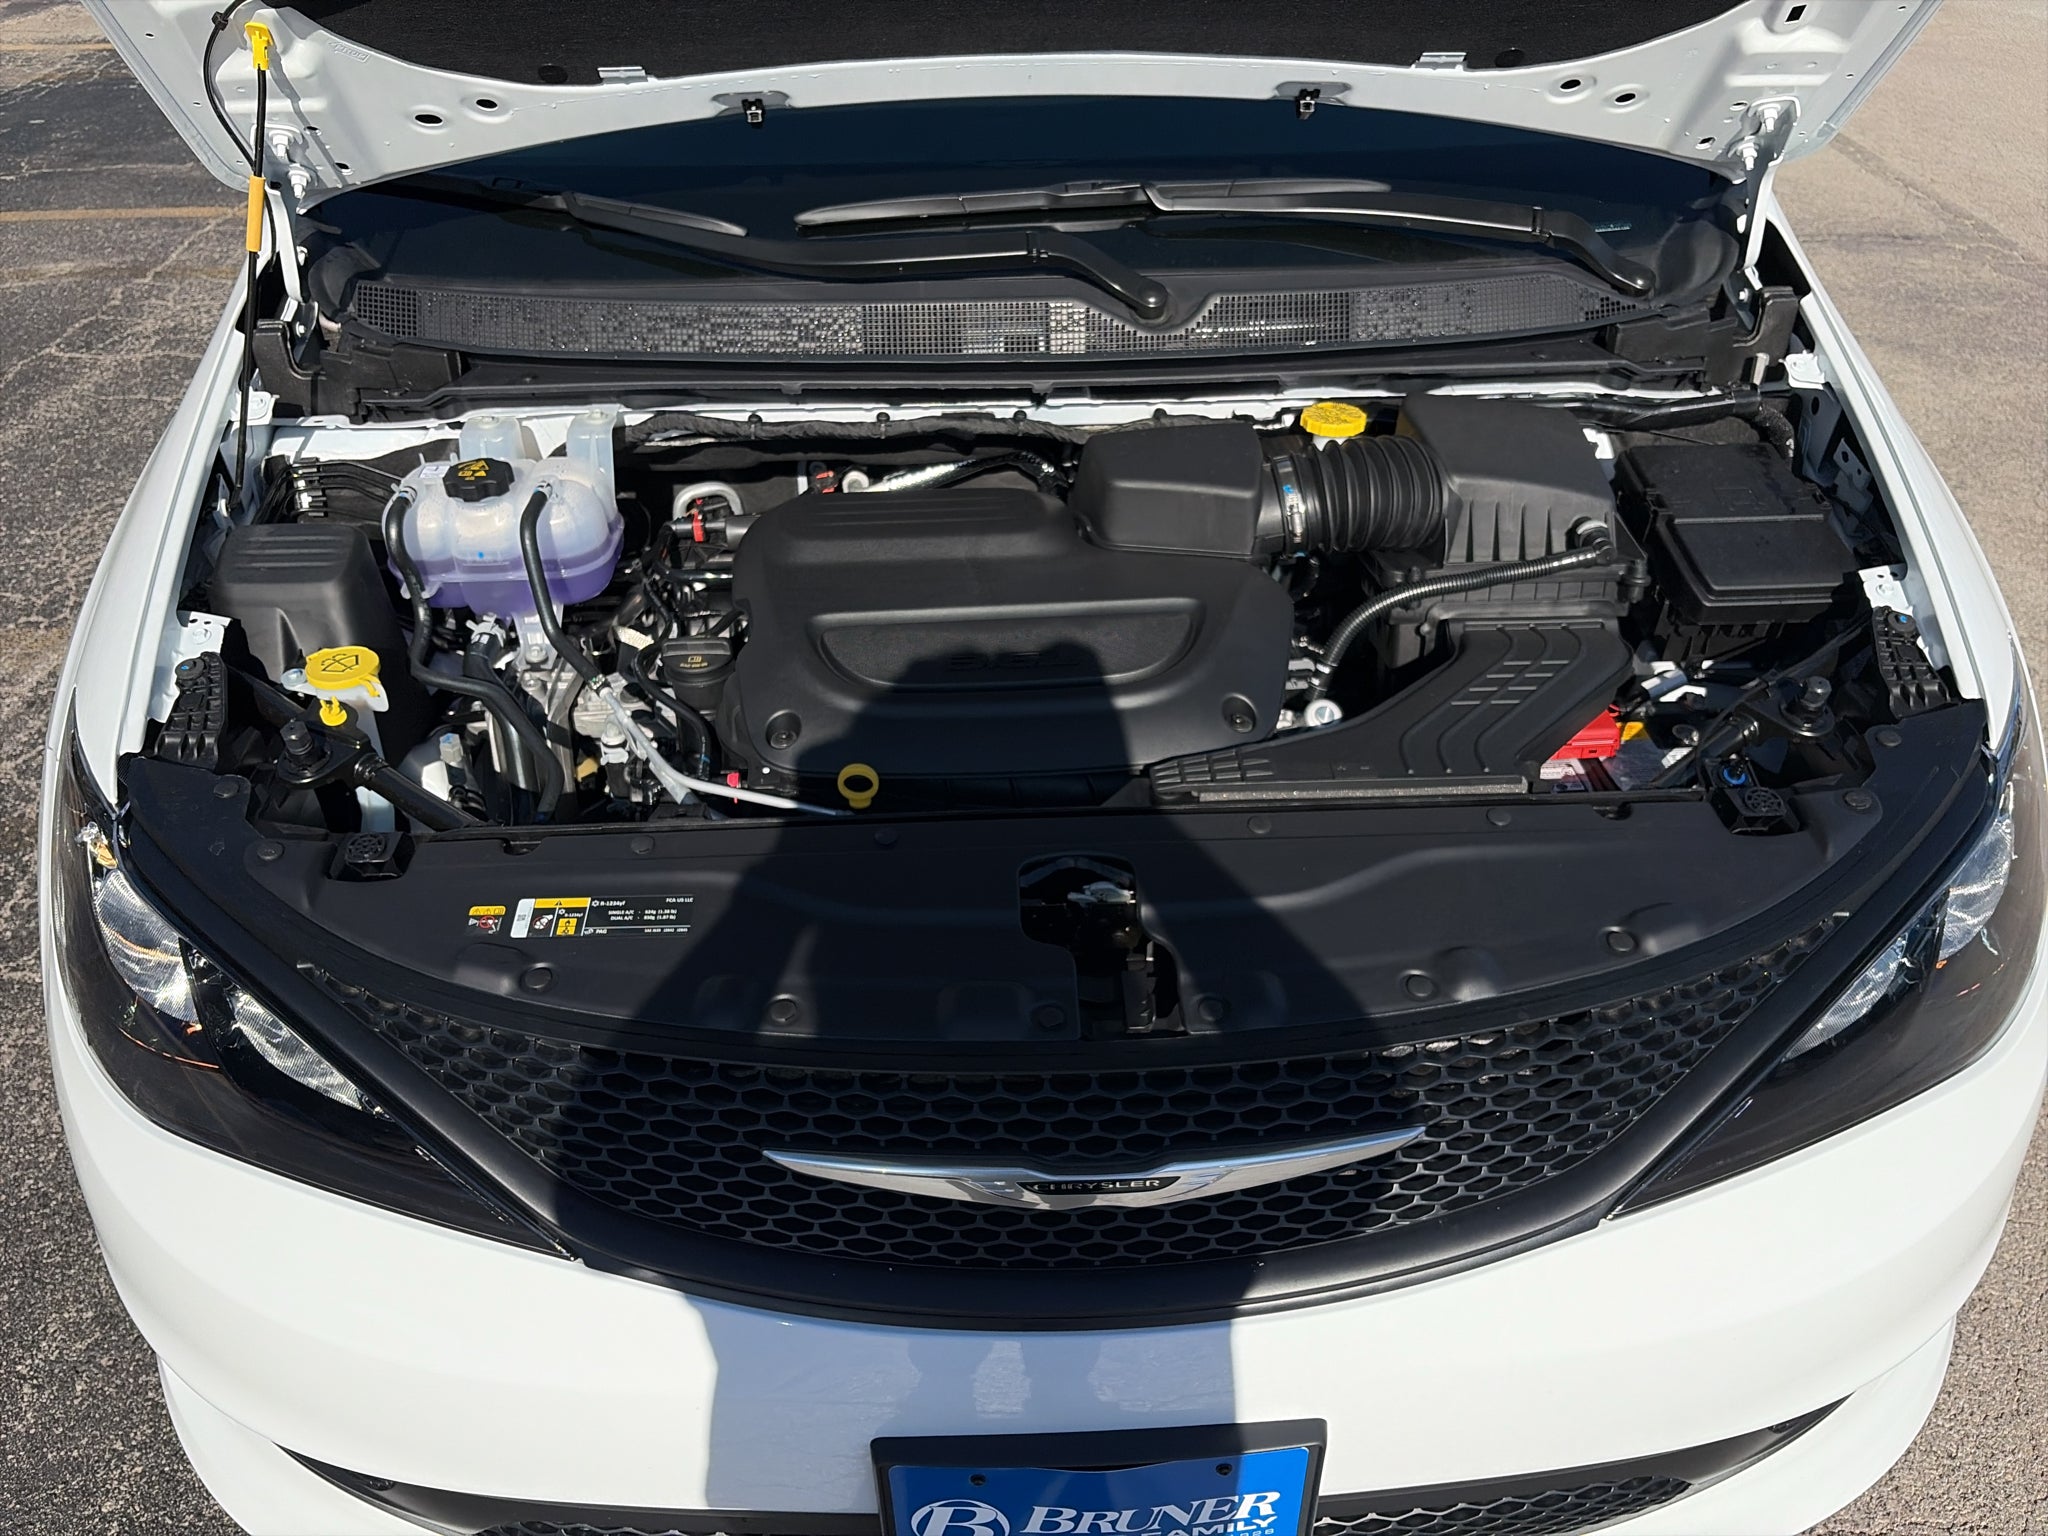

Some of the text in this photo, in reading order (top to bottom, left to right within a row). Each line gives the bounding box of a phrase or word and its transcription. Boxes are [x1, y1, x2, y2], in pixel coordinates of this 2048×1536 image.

[1031, 1179, 1160, 1191] CHRYSLER
[1019, 1491, 1281, 1535] BRUNER
[1141, 1515, 1278, 1536] AMILY
